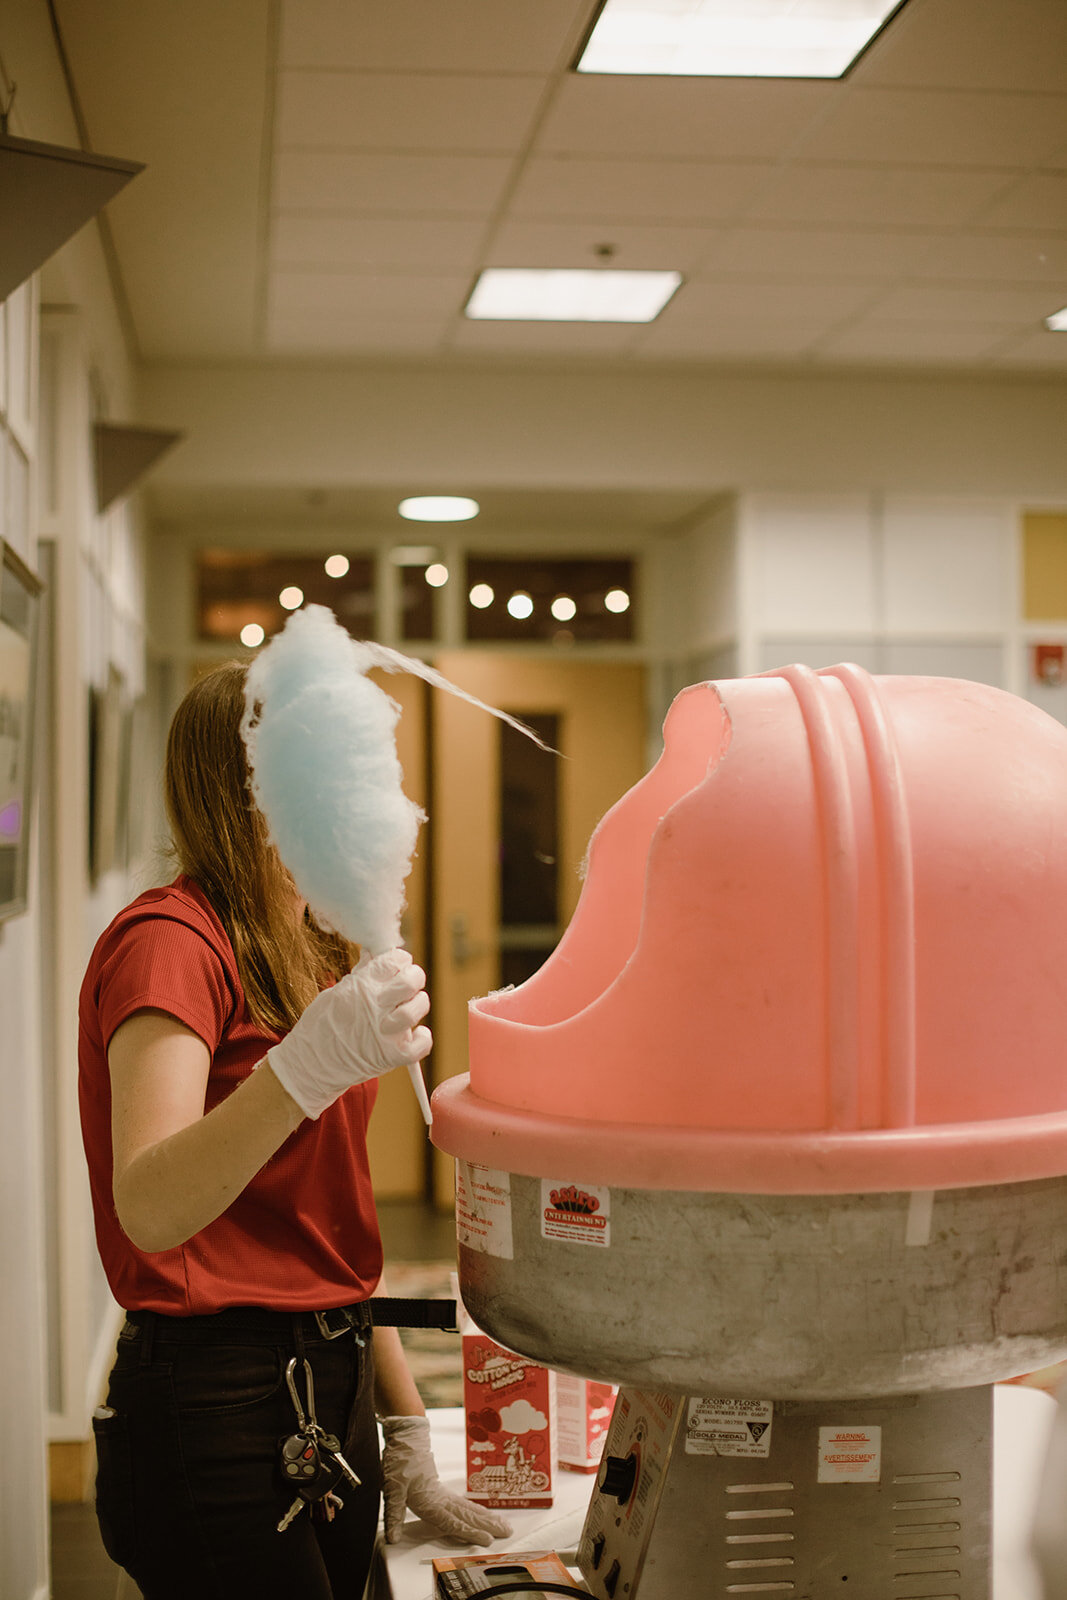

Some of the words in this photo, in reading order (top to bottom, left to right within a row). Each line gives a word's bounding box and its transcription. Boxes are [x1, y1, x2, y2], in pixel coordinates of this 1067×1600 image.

[549, 1185, 600, 1211] astro
[544, 1211, 606, 1226] ENTERTAINMENT
[466, 1360, 512, 1384] COTTON
[490, 1369, 526, 1391] MAGIC
[702, 1398, 732, 1406] ECONO
[734, 1399, 761, 1407] FLOSS
[835, 1432, 866, 1440] WARNING
[823, 1453, 877, 1462] AVERTISSEMENT
